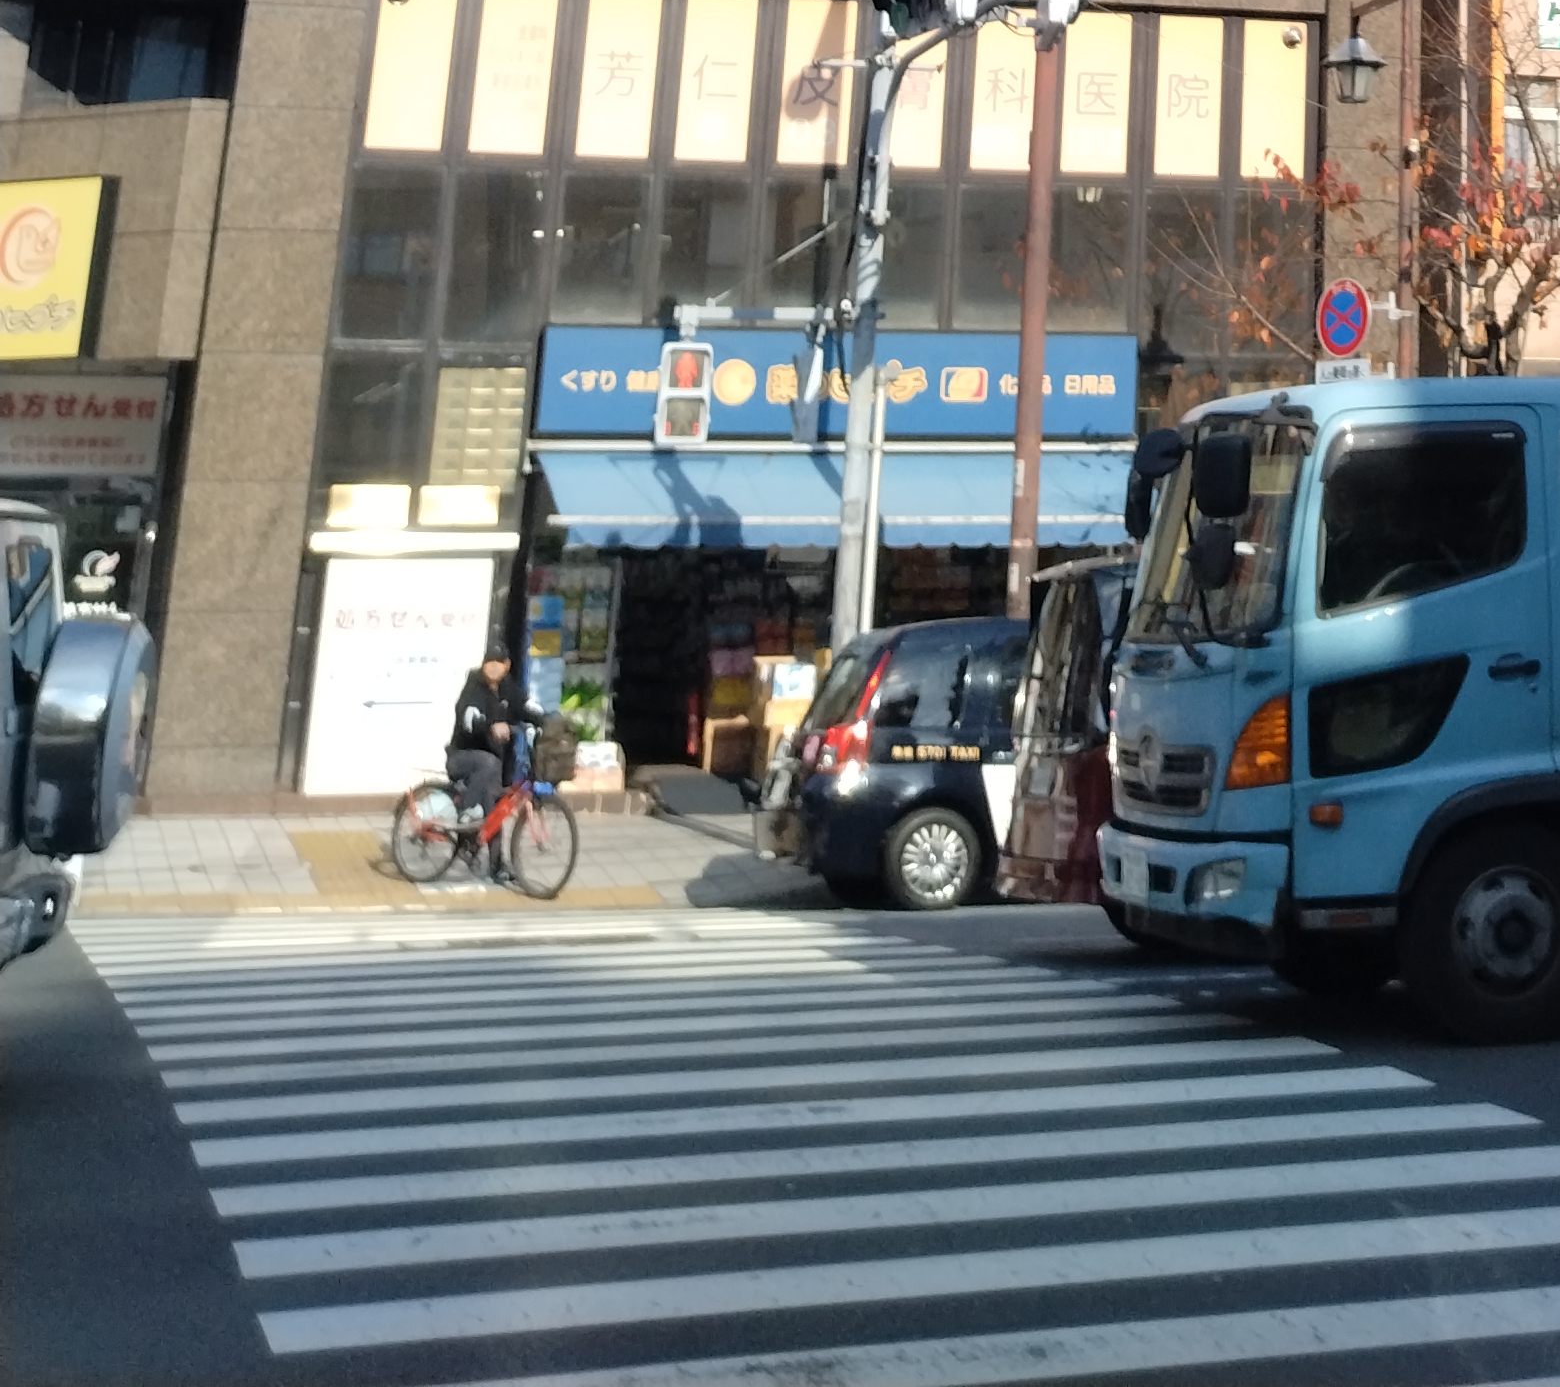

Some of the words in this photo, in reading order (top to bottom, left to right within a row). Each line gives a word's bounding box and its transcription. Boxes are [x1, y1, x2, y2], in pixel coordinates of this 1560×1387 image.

[560, 369, 618, 393] くすり
[1064, 374, 1116, 397] 日用品
